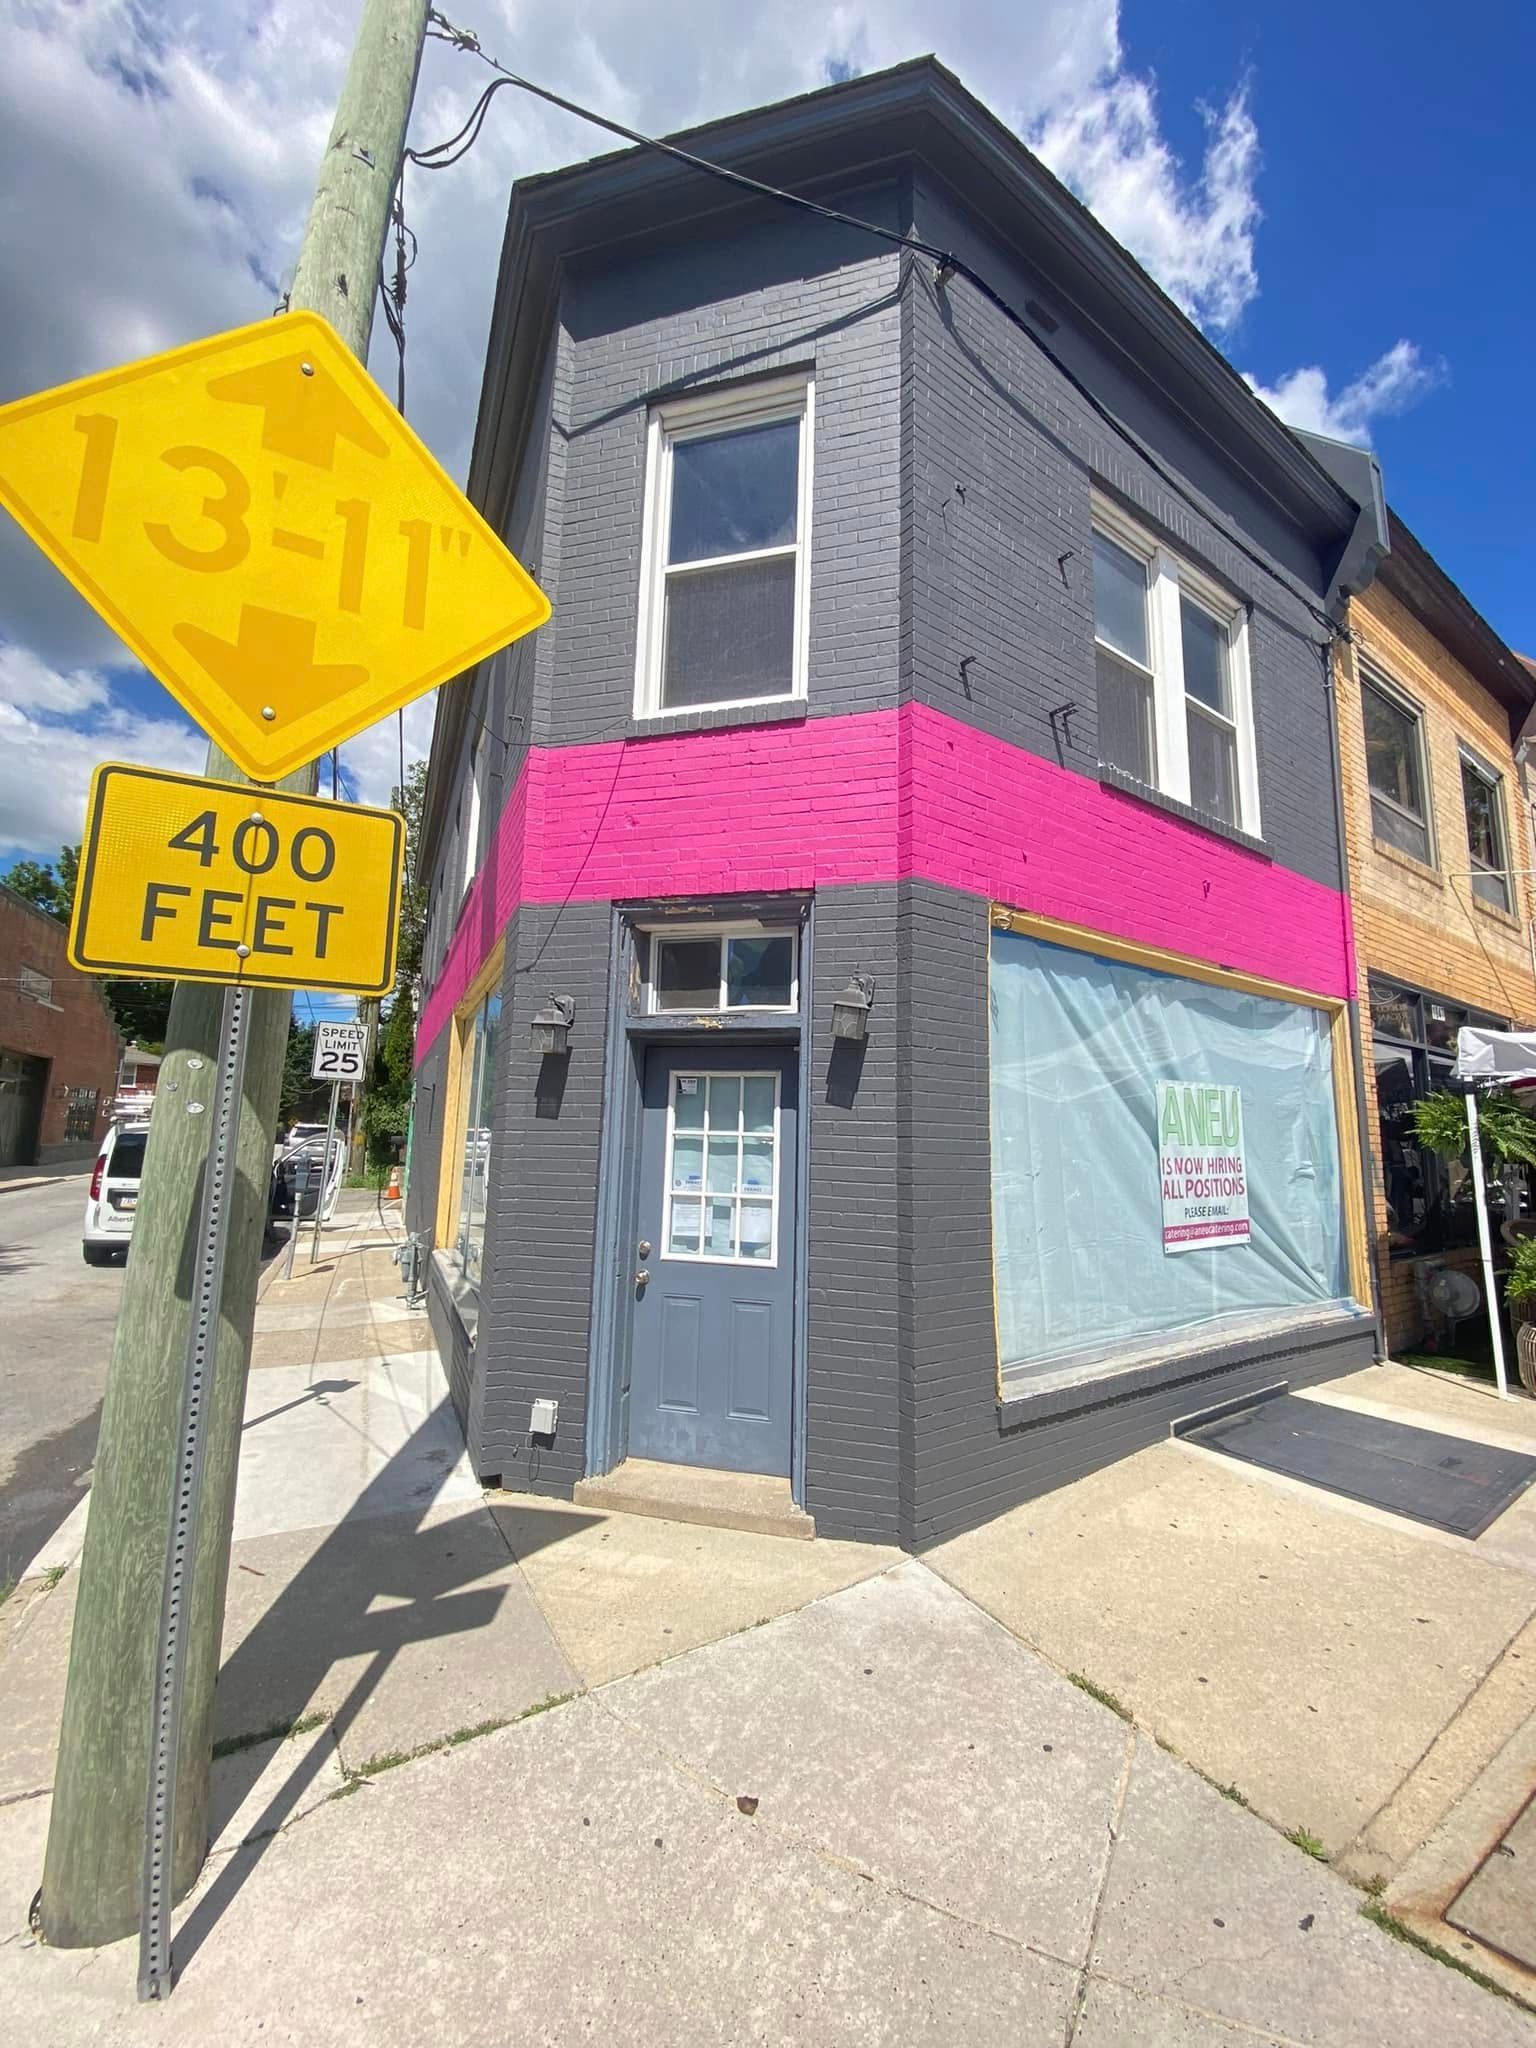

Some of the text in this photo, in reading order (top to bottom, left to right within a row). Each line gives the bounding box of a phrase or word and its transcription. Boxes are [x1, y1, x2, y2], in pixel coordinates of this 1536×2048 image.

[72, 413, 472, 631] 13'-11"
[168, 811, 336, 882] 400
[140, 882, 344, 959] FEET
[321, 1027, 365, 1040] SPEED
[325, 1040, 359, 1051] LIMIT
[319, 1051, 359, 1073] 25
[1162, 1086, 1240, 1148] ANEU
[1161, 1156, 1243, 1175] IS NOW HIRING
[1163, 1176, 1246, 1200] ALL POSITIONS
[1184, 1204, 1230, 1218] PLEASE EMAIL:
